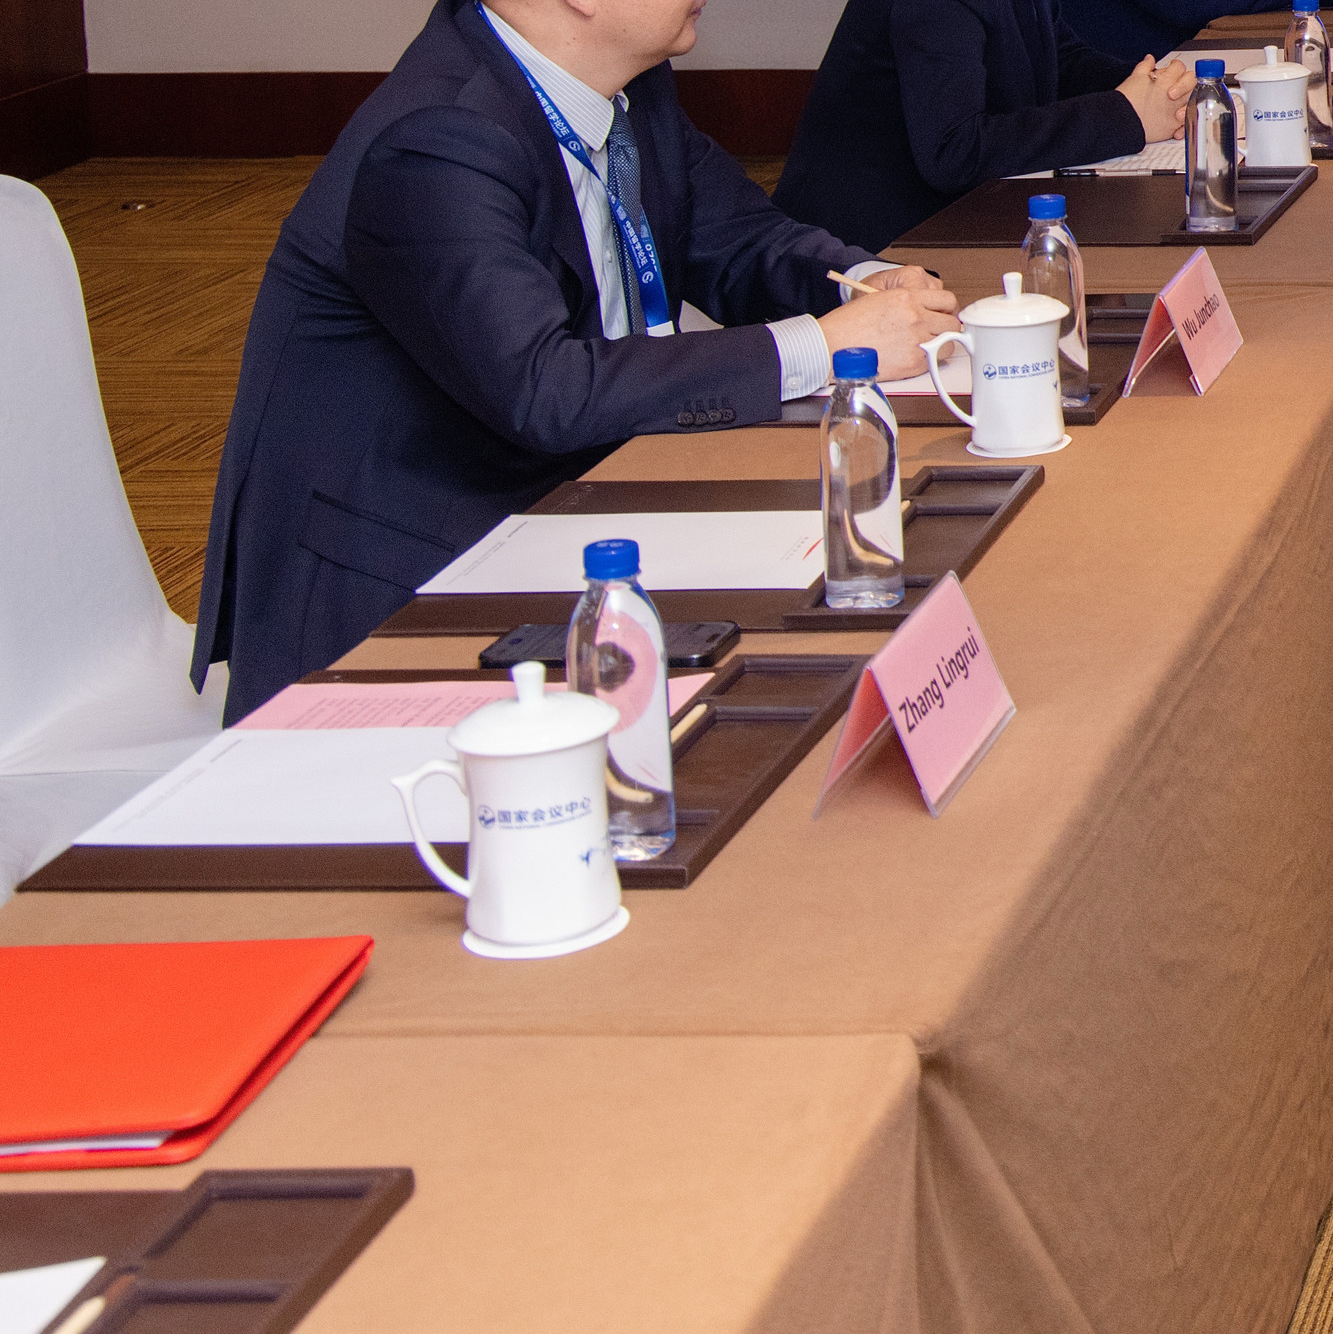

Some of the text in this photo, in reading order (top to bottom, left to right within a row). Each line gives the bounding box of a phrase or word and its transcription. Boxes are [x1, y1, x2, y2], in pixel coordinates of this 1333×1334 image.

[1182, 293, 1220, 341] Wu Junchao
[998, 358, 1055, 376] 国家会议中心
[898, 626, 980, 734] Zhang Lingrui
[497, 795, 592, 824] 国家会议中心
